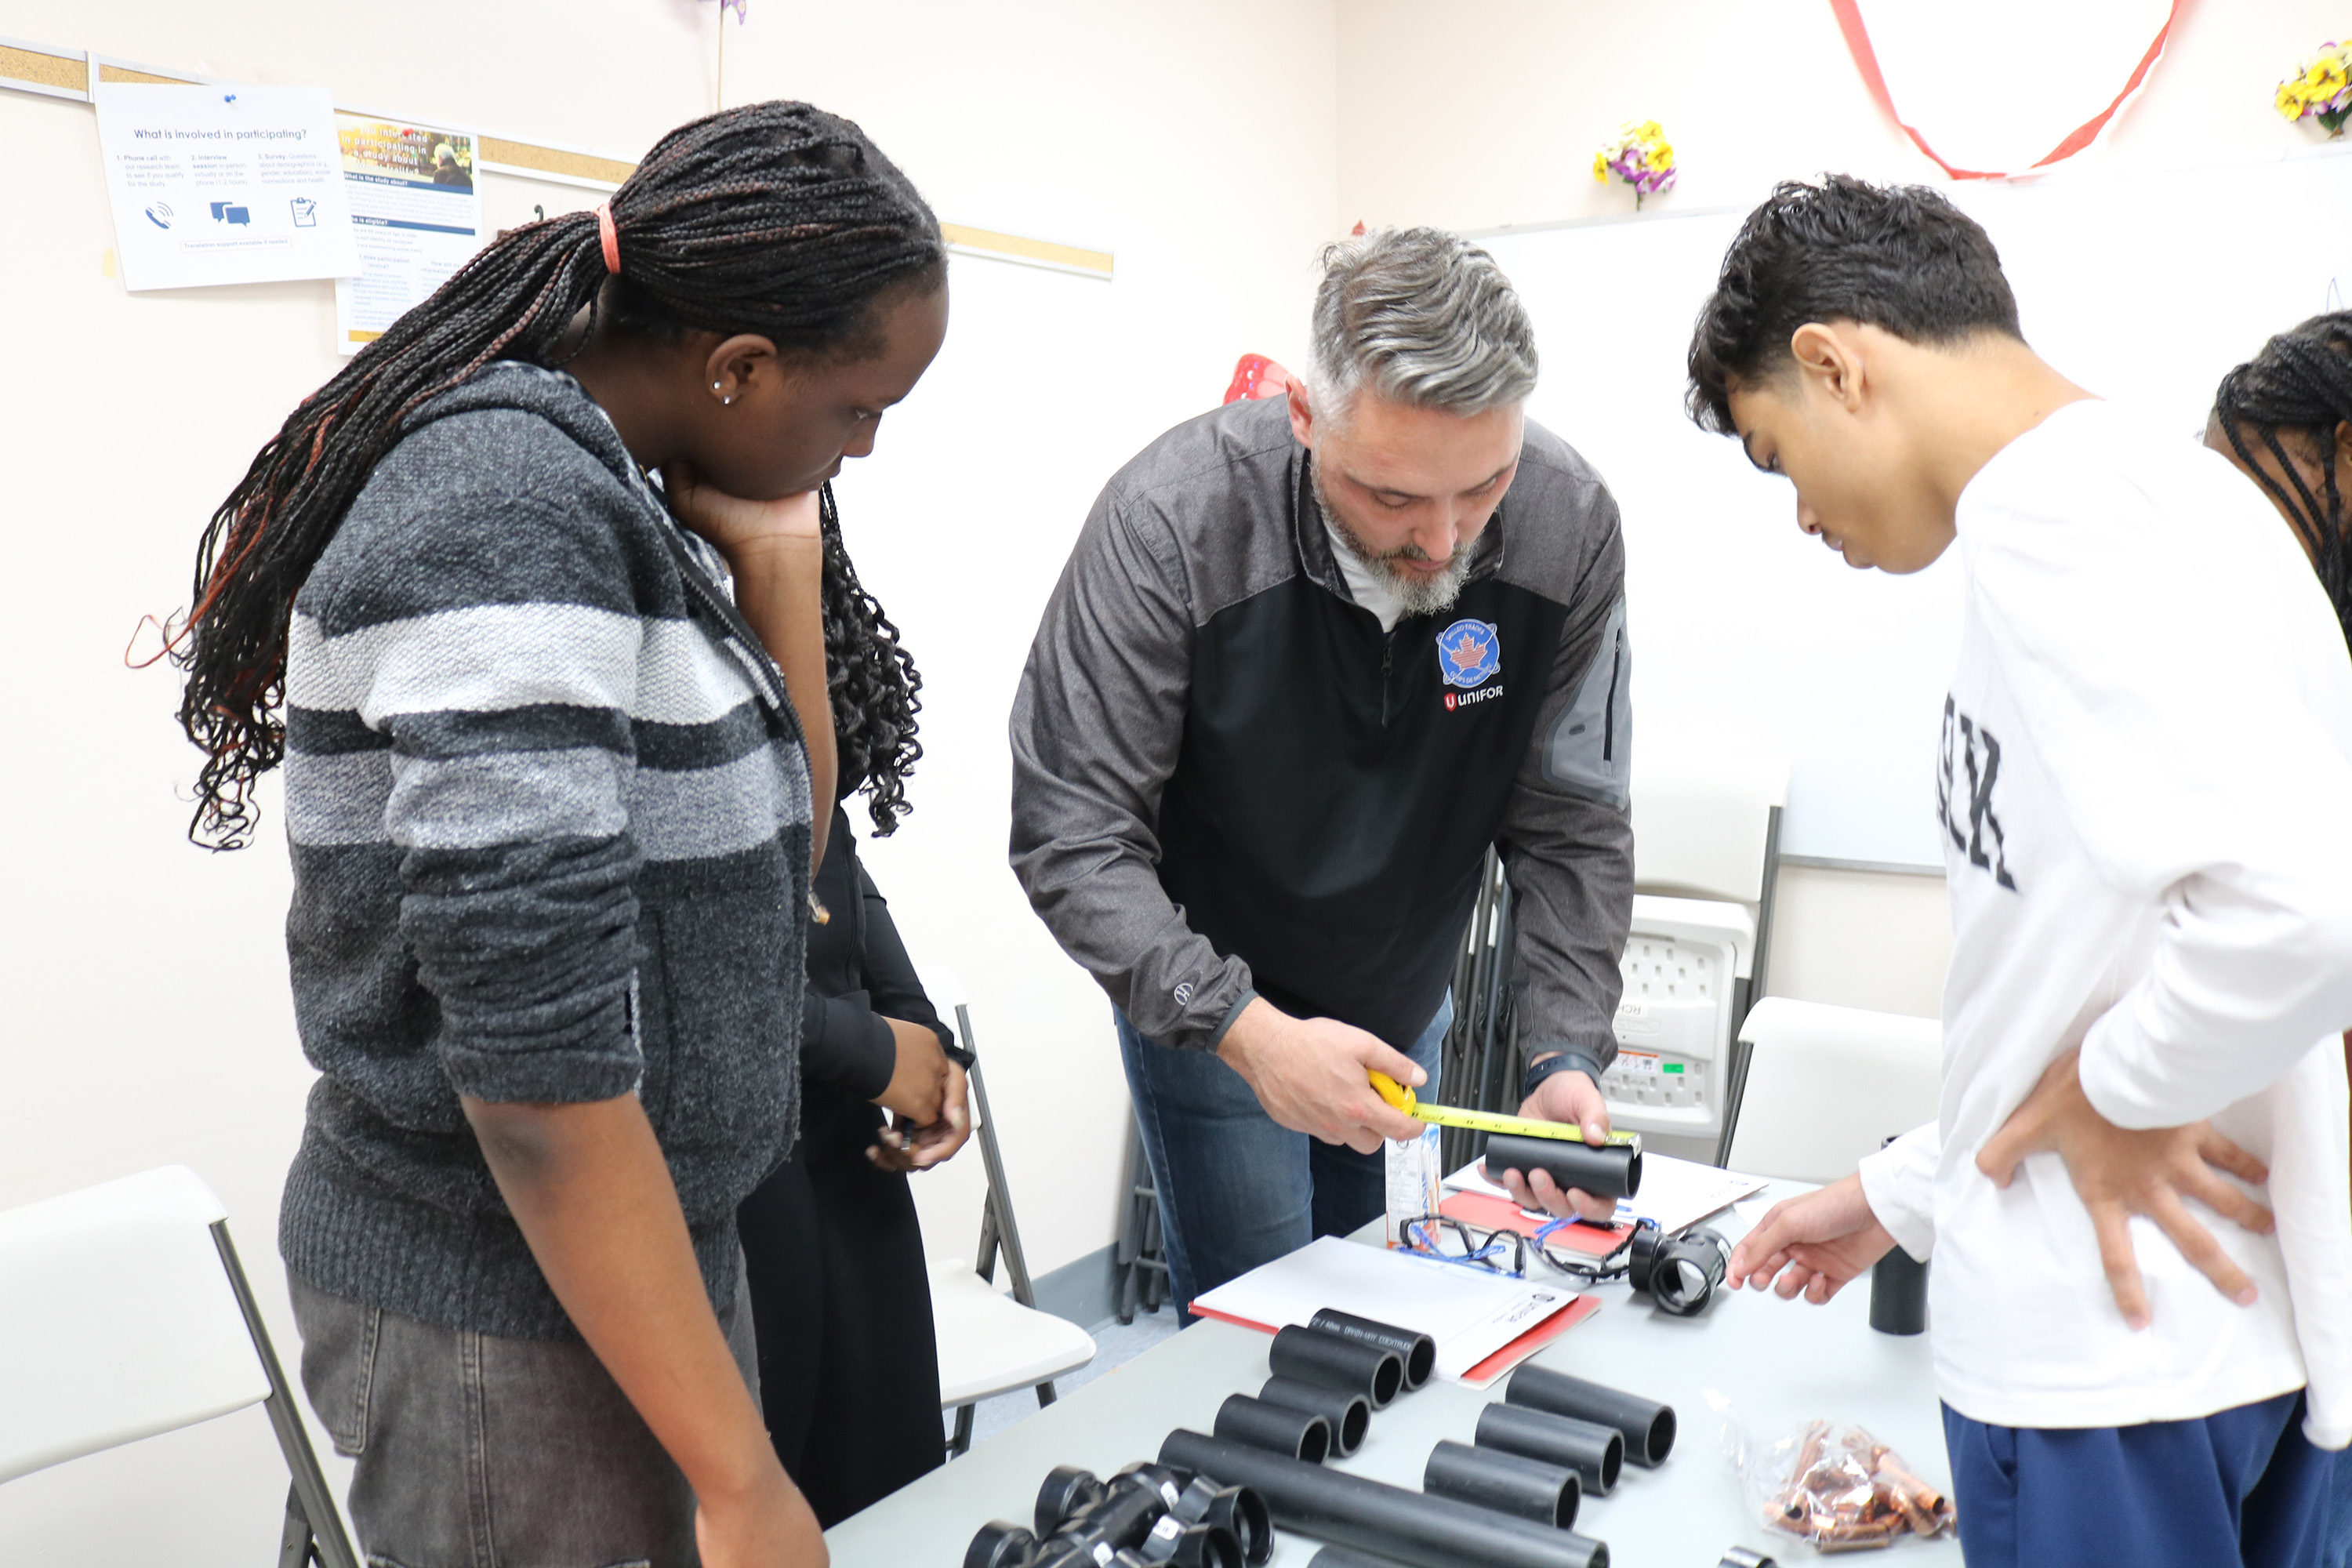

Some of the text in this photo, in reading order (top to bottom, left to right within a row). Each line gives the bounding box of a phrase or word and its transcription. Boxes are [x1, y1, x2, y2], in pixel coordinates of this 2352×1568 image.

[134, 129, 307, 141] What is involved in participating?
[355, 136, 415, 154] participating
[418, 145, 427, 154] in
[362, 150, 389, 162] study
[392, 154, 418, 165] about
[276, 161, 314, 169] demographics
[153, 172, 163, 180] you
[165, 171, 183, 180] qualify
[375, 176, 390, 185] study
[1457, 684, 1504, 706] UNIFOR
